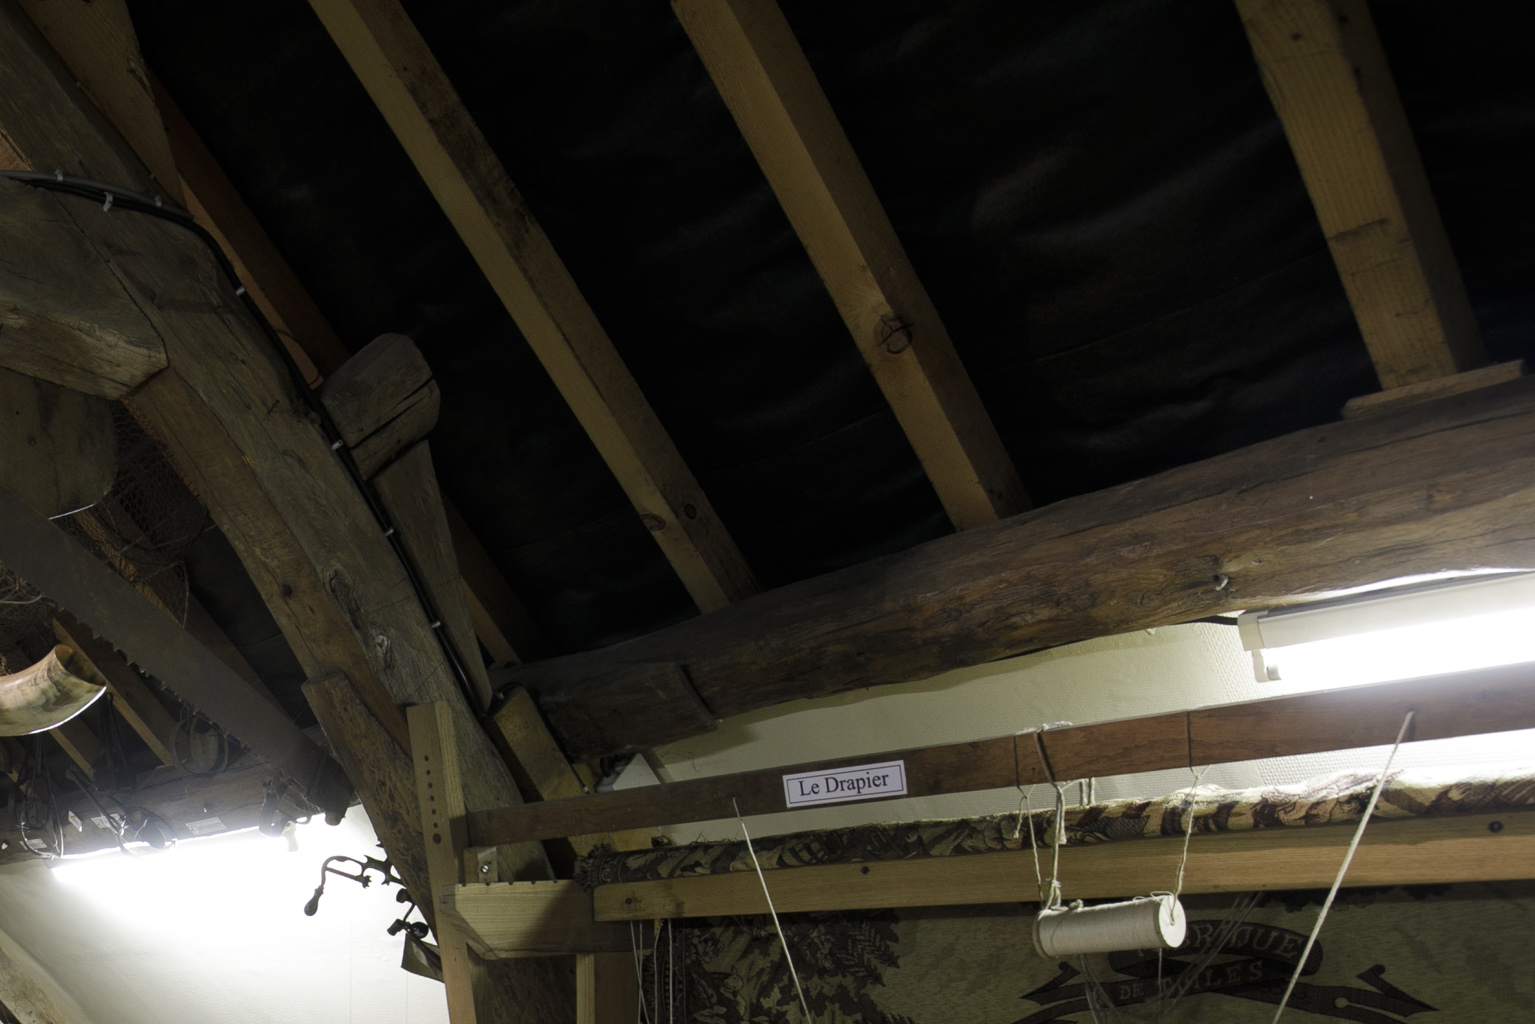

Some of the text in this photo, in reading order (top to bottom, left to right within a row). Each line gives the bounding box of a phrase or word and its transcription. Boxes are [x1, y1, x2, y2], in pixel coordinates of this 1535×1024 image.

[799, 772, 889, 796] Le Drapier
[1119, 984, 1145, 999] DE
